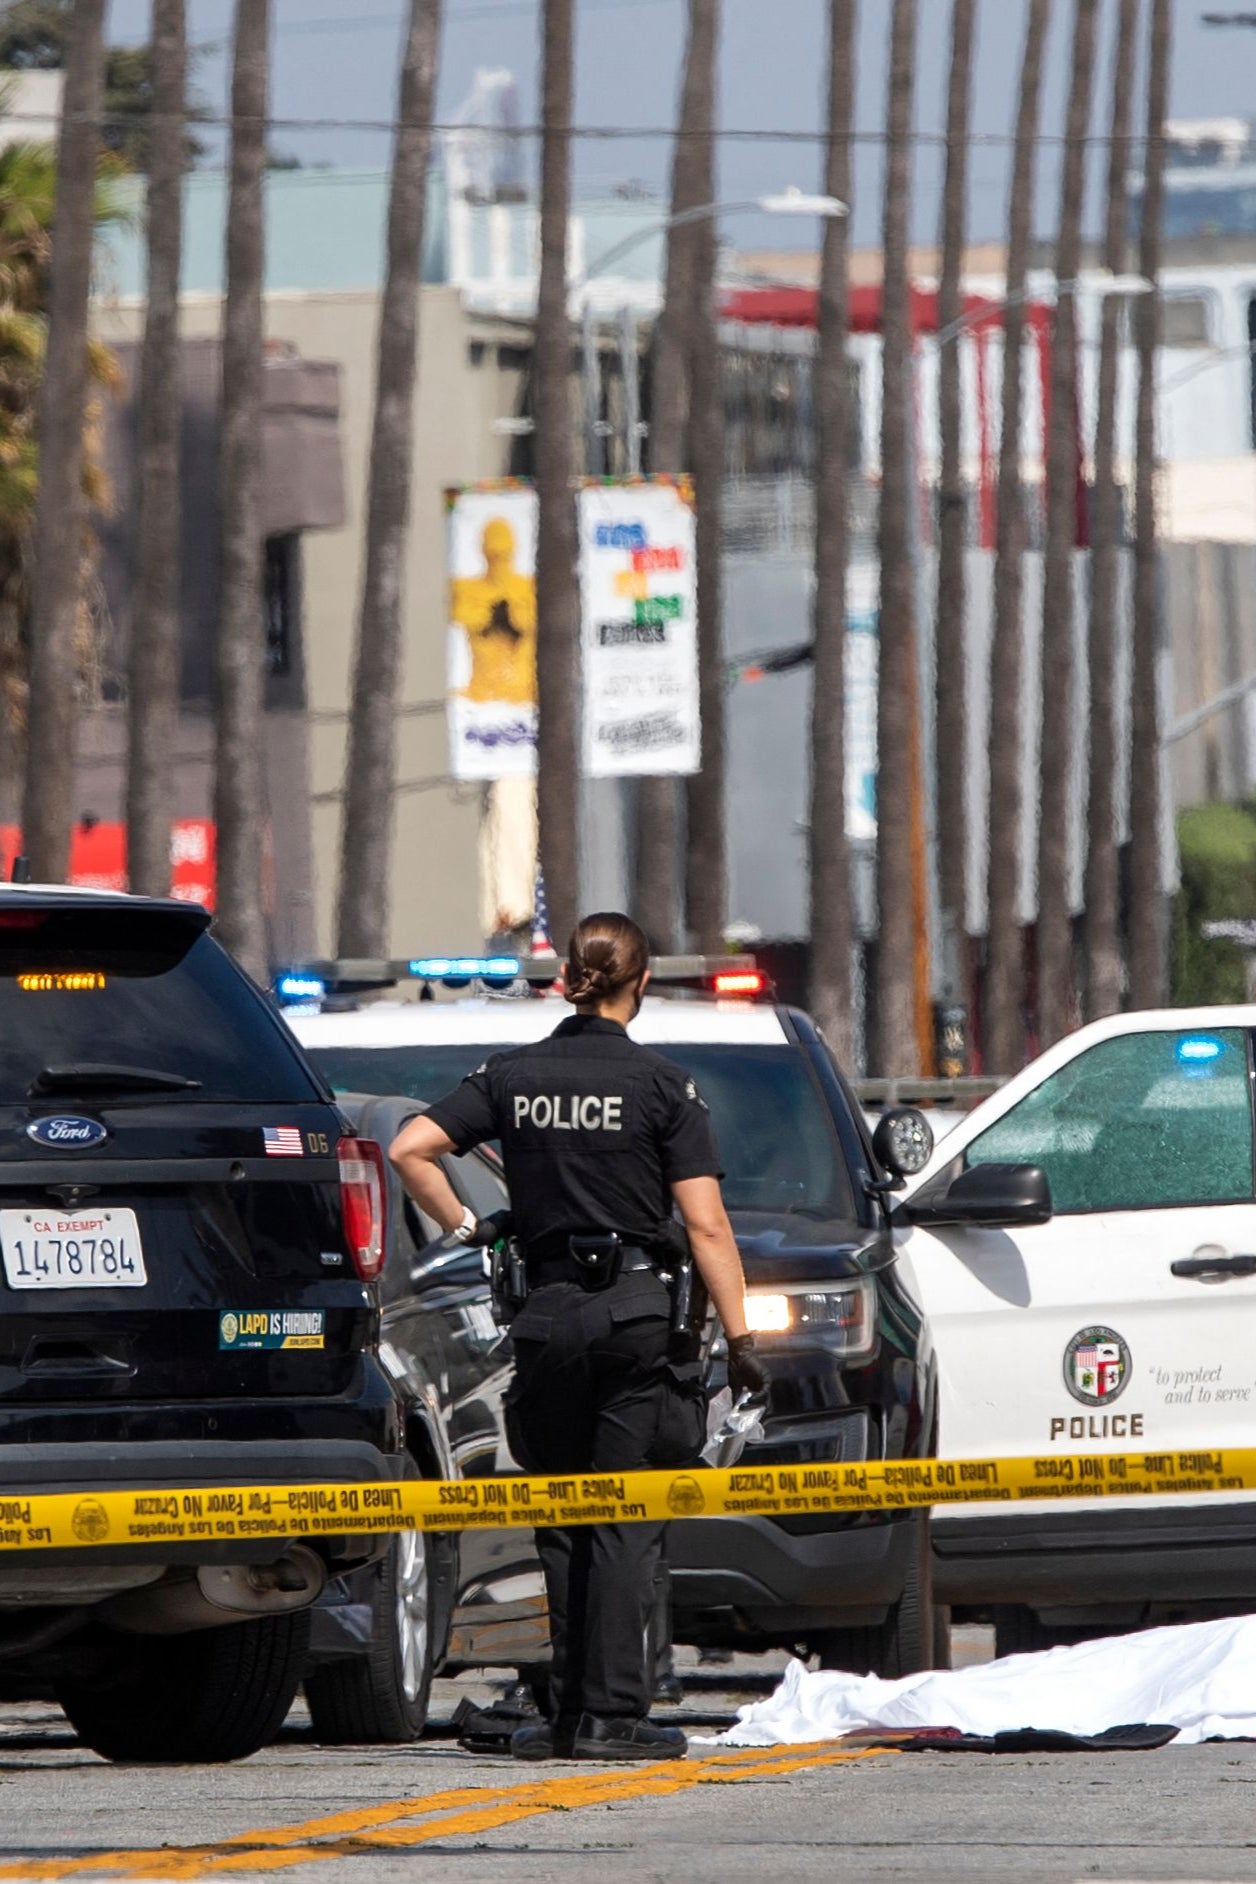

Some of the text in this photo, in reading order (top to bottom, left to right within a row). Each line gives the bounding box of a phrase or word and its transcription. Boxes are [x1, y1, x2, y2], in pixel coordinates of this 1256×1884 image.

[514, 1095, 623, 1131] POLICE
[48, 1120, 92, 1140] Ford
[34, 1220, 104, 1233] CA EXEMPT
[14, 1239, 135, 1275] 1478784
[239, 1313, 322, 1335] LAPD IS HIRING!
[1174, 1364, 1222, 1388] protect
[1165, 1386, 1193, 1404] and
[1198, 1387, 1211, 1403] to
[1050, 1413, 1144, 1441] POLICE
[937, 1461, 955, 1487] De
[1034, 1458, 1073, 1479] Cross
[1078, 1457, 1102, 1480] Not
[1179, 1451, 1223, 1474] Police
[581, 1477, 625, 1501] Police
[729, 1471, 774, 1493] Cruzar
[778, 1470, 797, 1493] No
[802, 1468, 838, 1490] Favor
[134, 1495, 178, 1517] Cruzar
[183, 1494, 202, 1517] No
[207, 1492, 243, 1514] Favor
[339, 1489, 358, 1512] De
[439, 1483, 478, 1506] Cross
[482, 1483, 505, 1506] Not
